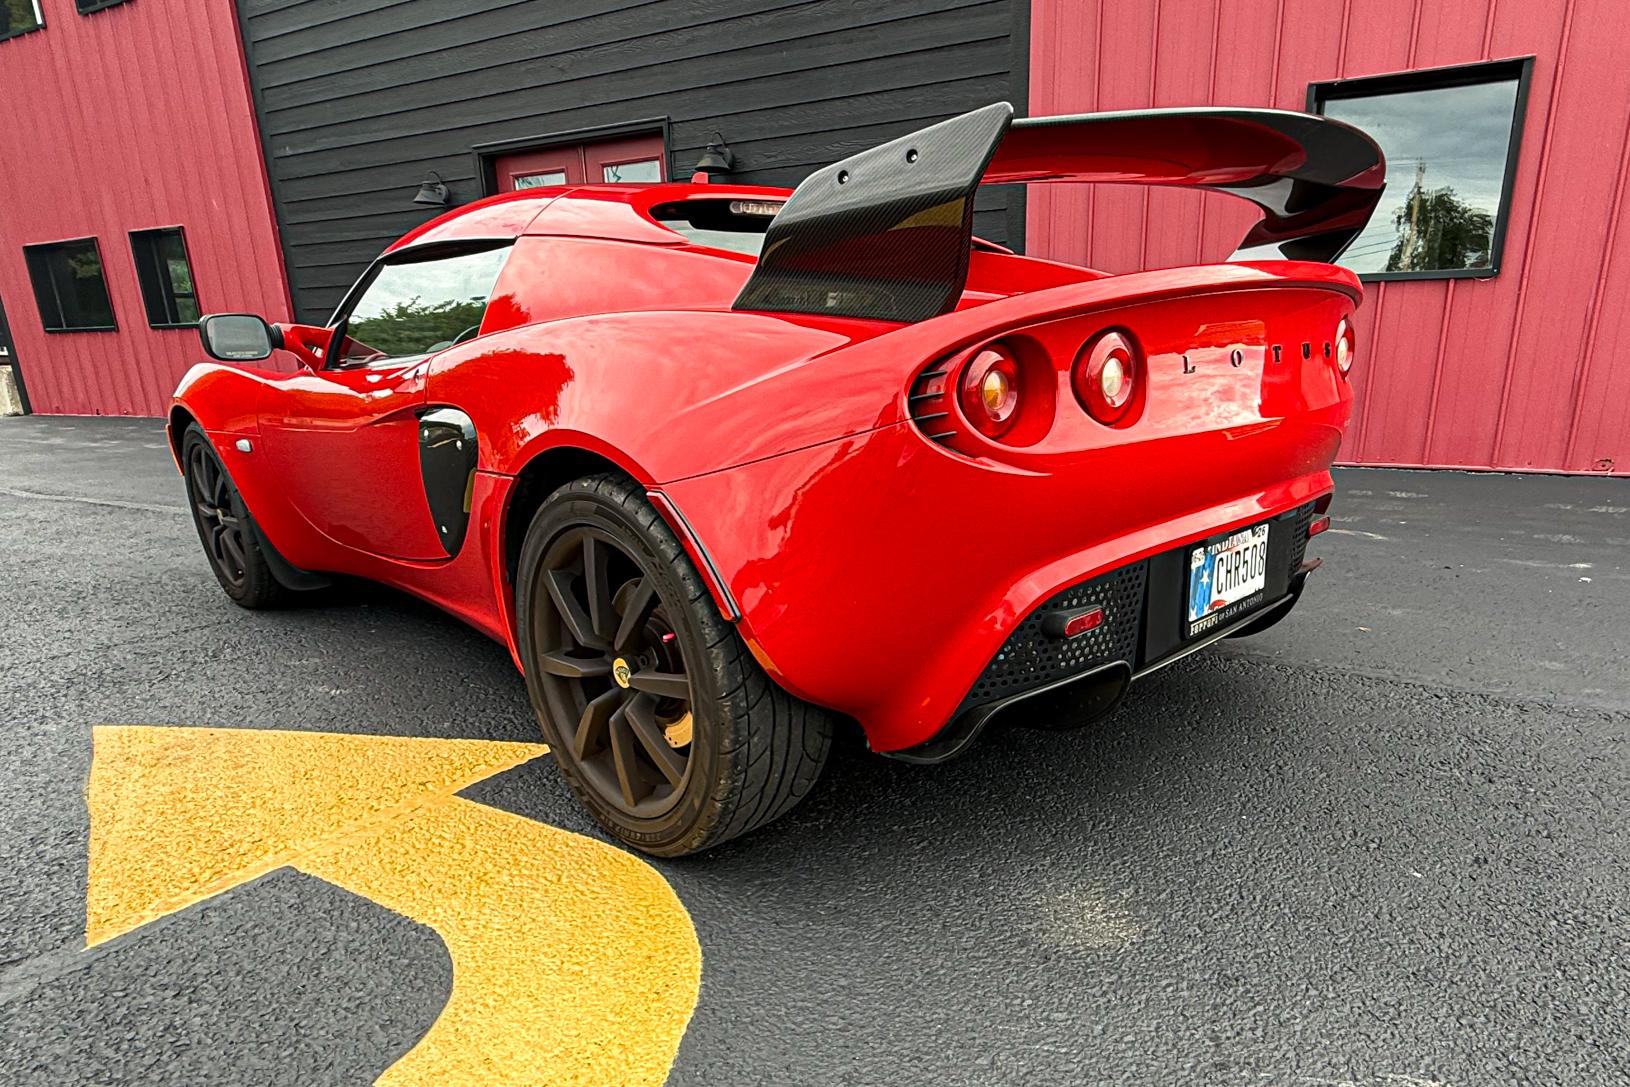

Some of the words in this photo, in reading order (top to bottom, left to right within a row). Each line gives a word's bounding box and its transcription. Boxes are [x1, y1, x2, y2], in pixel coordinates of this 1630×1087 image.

[1182, 342, 1331, 374] LOTUS
[1216, 541, 1266, 594] CHR508
[1225, 604, 1238, 619] SAN
[1238, 593, 1264, 611] ANTONIO
